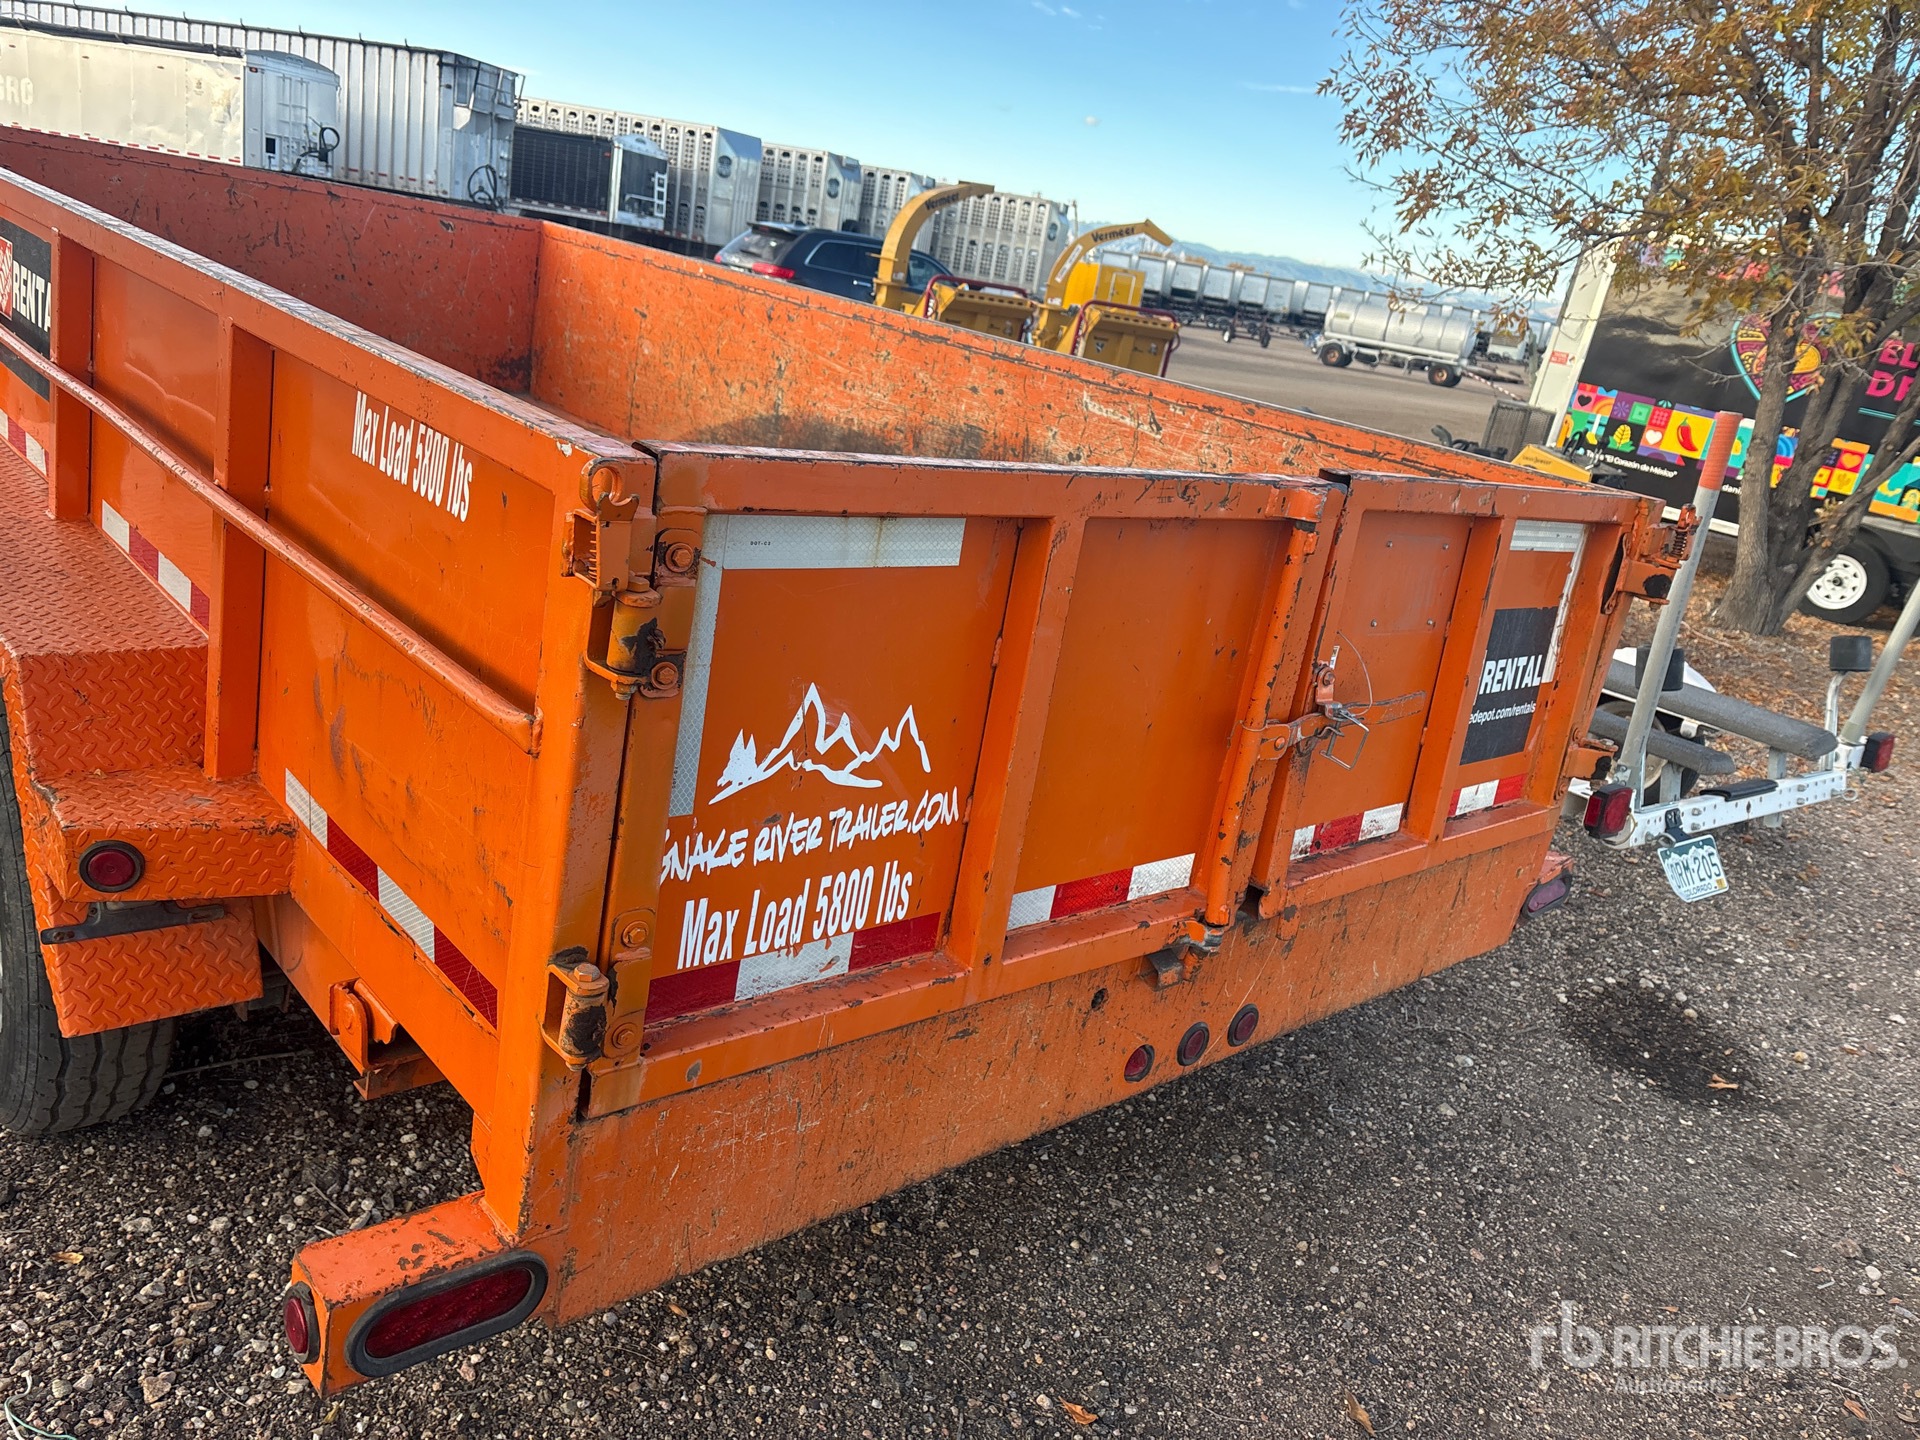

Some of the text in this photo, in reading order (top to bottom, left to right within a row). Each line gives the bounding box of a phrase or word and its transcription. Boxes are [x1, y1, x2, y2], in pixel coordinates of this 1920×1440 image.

[1091, 227, 1135, 242] Vermeer
[352, 390, 473, 523] Max Load 5800 lbs
[1640, 463, 1650, 472] de
[1479, 654, 1543, 695] RENTAL
[660, 786, 959, 885] SNAKE RIVER TRAILER.COM
[676, 860, 913, 970] Max Load 5800 lbs
